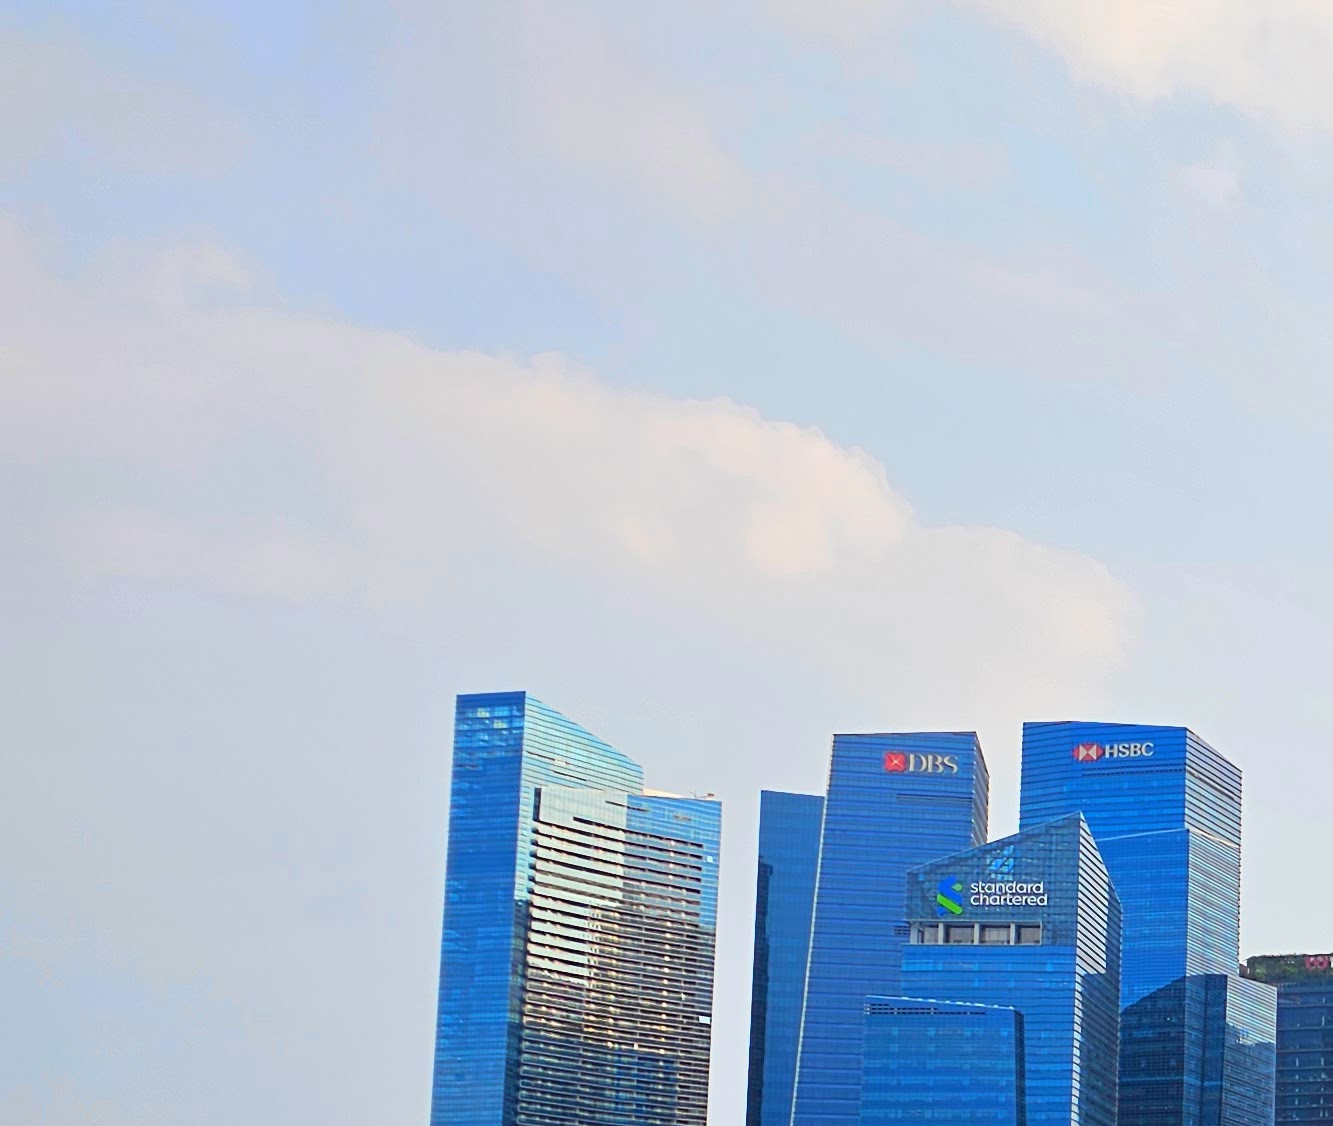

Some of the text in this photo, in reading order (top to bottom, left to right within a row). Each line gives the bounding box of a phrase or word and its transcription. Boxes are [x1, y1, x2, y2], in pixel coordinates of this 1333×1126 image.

[1104, 742, 1154, 759] HSBC
[908, 752, 959, 774] DBS
[970, 880, 1045, 895] standard
[970, 892, 1048, 907] chartered
